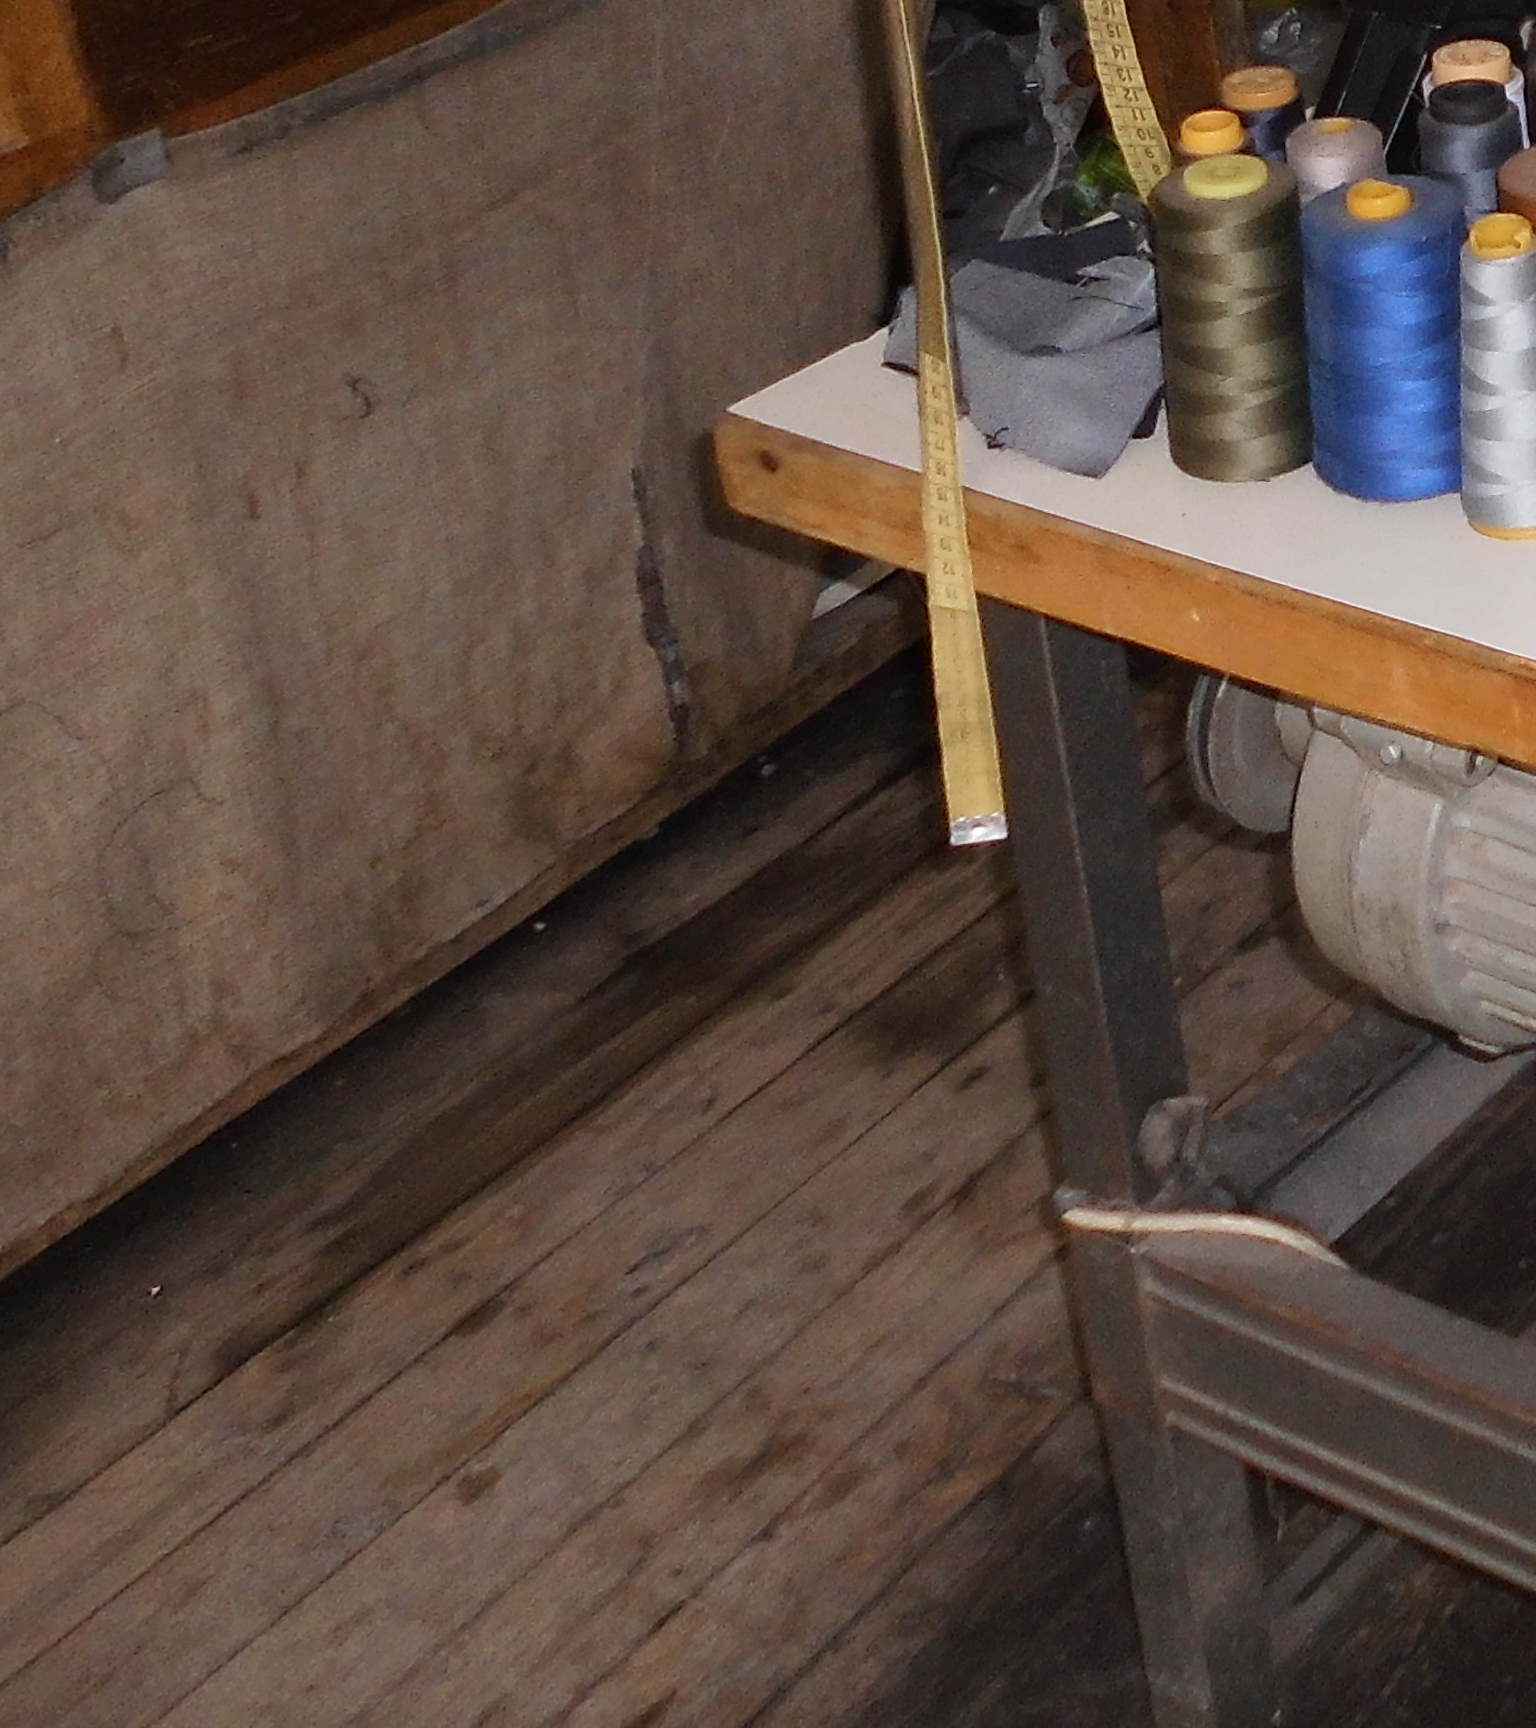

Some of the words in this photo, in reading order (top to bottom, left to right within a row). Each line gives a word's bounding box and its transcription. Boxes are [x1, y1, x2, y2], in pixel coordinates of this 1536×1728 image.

[1106, 23, 1122, 38] 15
[1112, 46, 1127, 61] 14
[1118, 68, 1133, 82] 13
[1124, 87, 1140, 101] 12
[1131, 109, 1147, 121] 11
